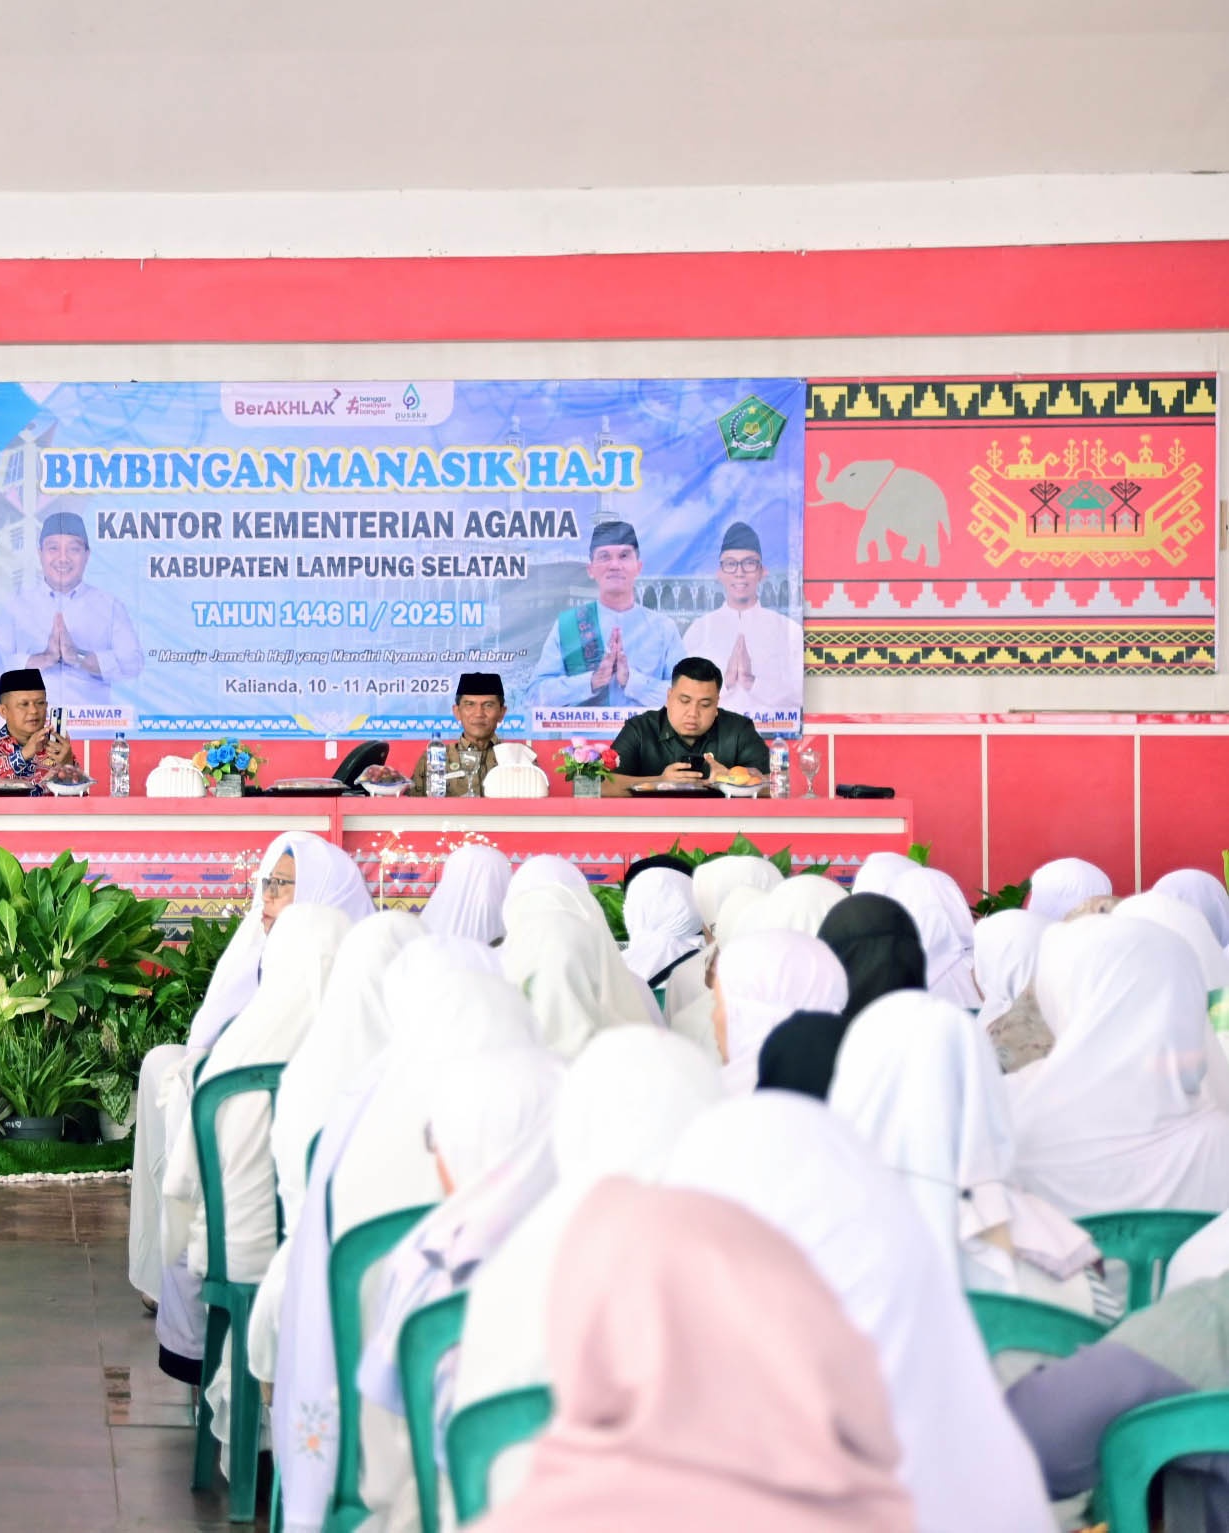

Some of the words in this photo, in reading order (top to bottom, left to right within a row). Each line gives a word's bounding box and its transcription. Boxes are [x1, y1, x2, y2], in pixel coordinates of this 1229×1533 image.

[234, 400, 336, 416] BerAKHLAK
[43, 452, 298, 489] BIMBINGAN
[307, 451, 518, 488] MANASIK
[526, 451, 636, 487] HAJI
[97, 511, 222, 539] KANTOR
[232, 511, 454, 539] KEMENTERIAN
[463, 510, 579, 538] AGAMA
[150, 556, 289, 578] KABUPATEN
[296, 556, 414, 577] LAMPUNG
[421, 555, 526, 577] SELATAN
[192, 602, 275, 627] TAHUN
[281, 602, 343, 626] 1446
[348, 602, 367, 626] H
[392, 602, 454, 626] 2025
[461, 602, 484, 626] M
[158, 650, 207, 664] Menuju
[267, 650, 294, 664] Haji
[295, 652, 329, 664] yang
[331, 650, 381, 662] Mandiri
[382, 650, 438, 664] Nyaman
[439, 650, 465, 662] dan
[468, 650, 515, 662] Mabrur
[226, 679, 302, 694] Kalianda,
[308, 680, 327, 693] 10
[344, 680, 360, 693] 11
[365, 679, 405, 695] April
[410, 679, 450, 693] 2025
[78, 709, 122, 718] ANWAR
[535, 711, 546, 720] H.
[550, 711, 599, 722] ASHARI,
